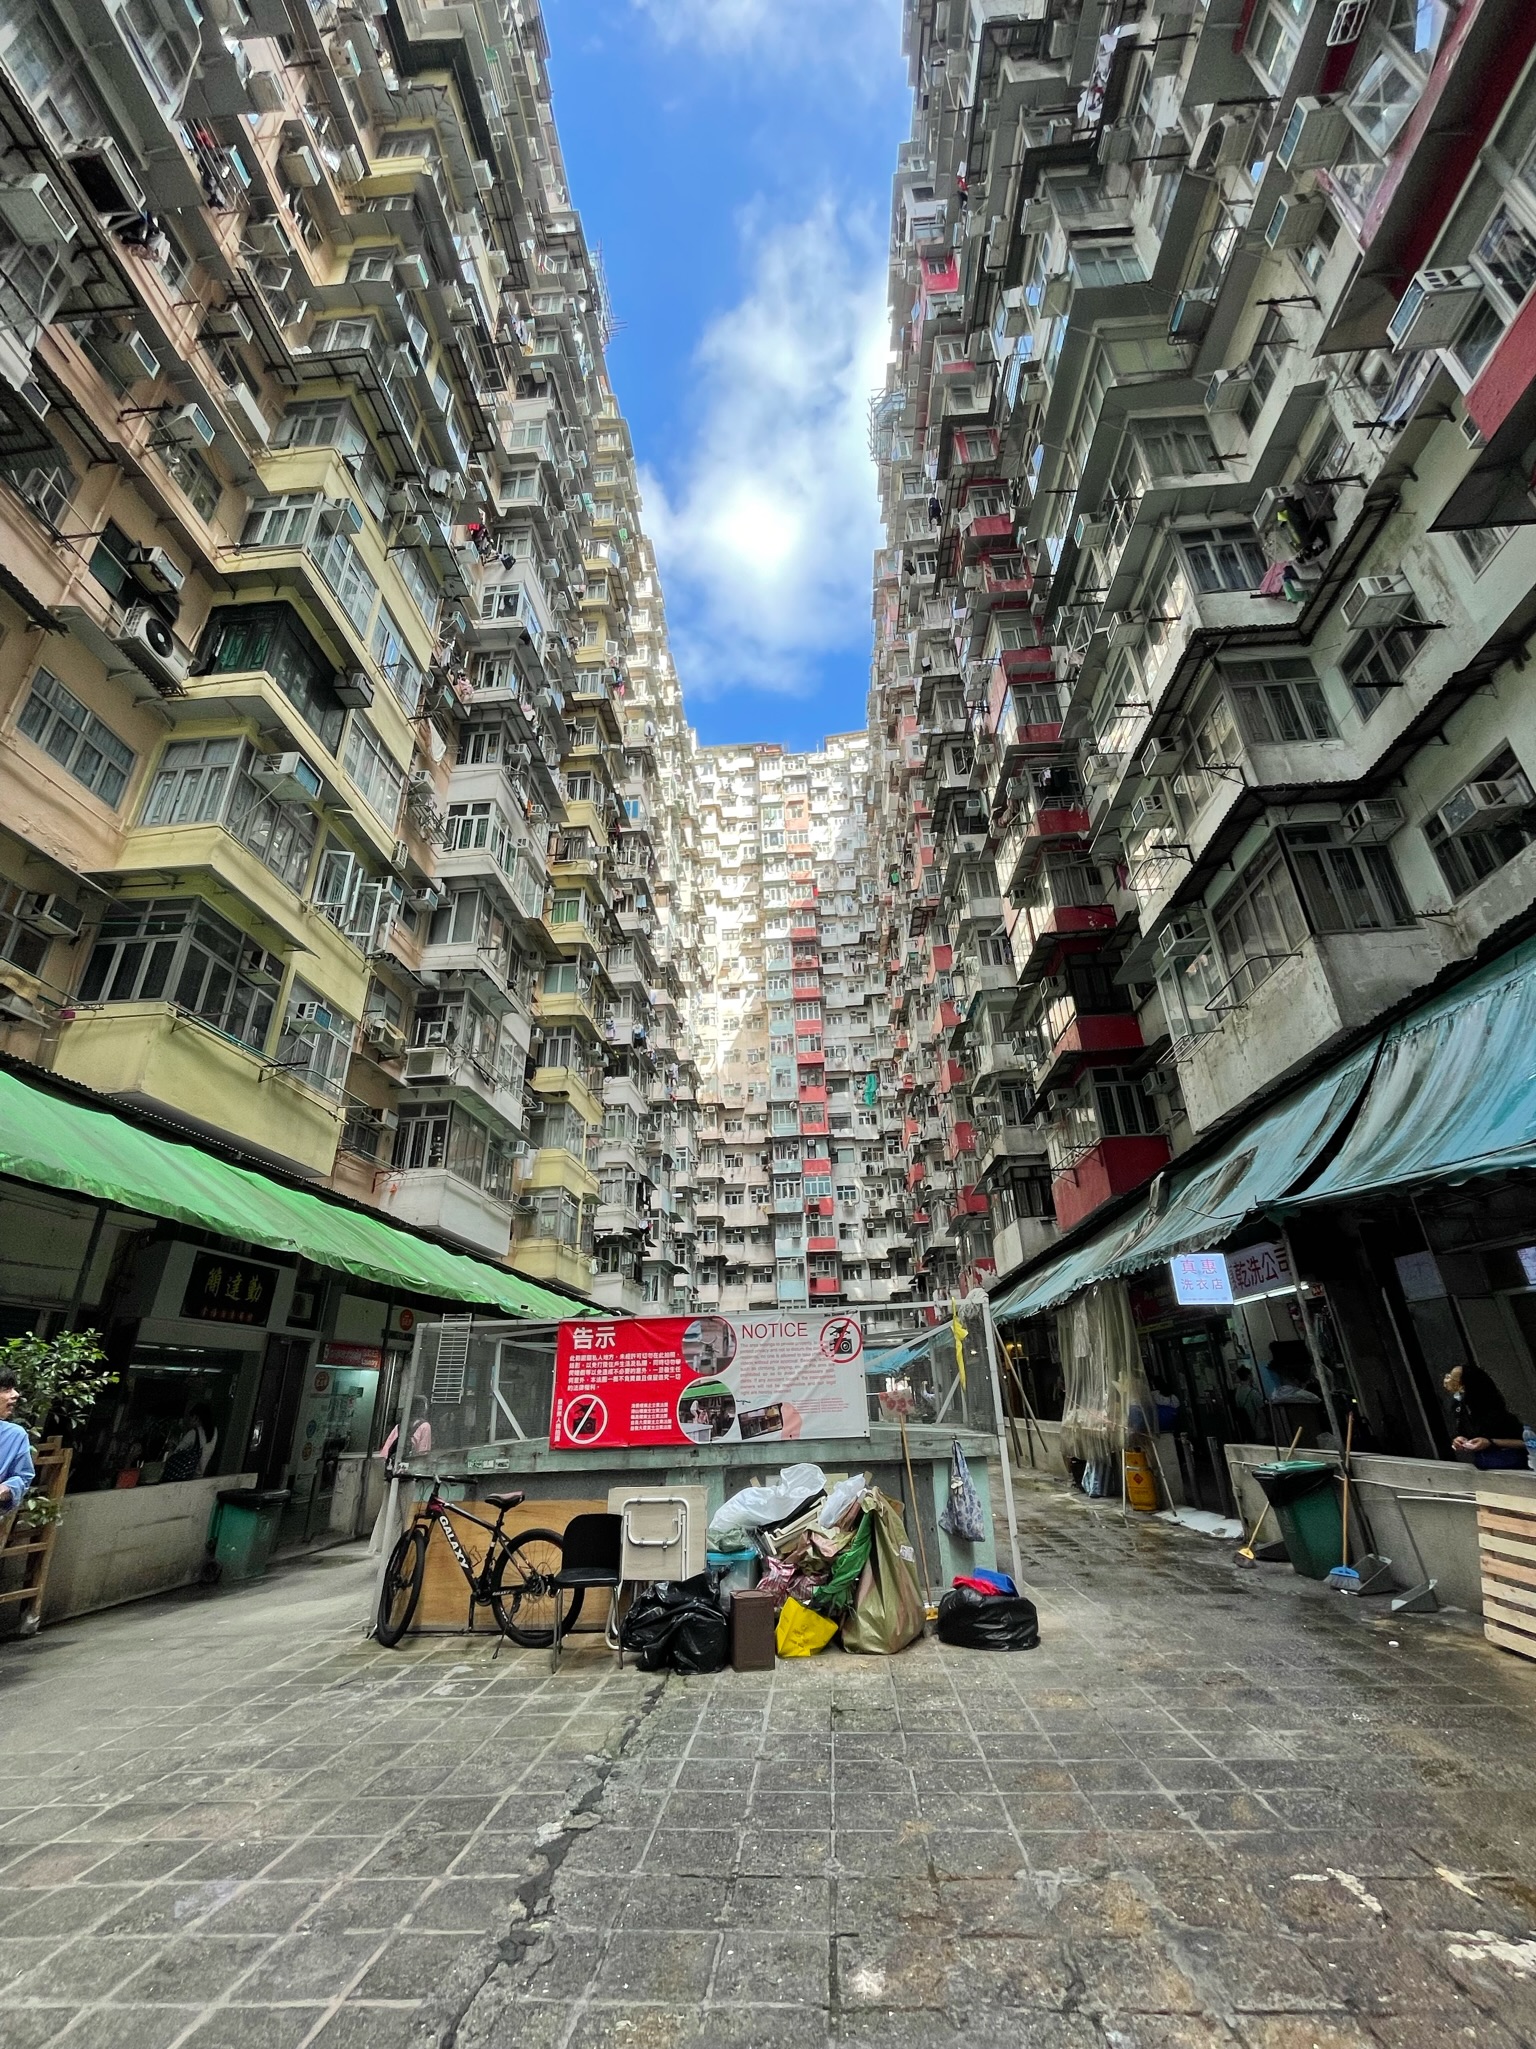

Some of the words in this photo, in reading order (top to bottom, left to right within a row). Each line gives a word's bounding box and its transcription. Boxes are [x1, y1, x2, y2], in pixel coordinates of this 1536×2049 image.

[1180, 1259, 1217, 1275] 真惠
[1180, 1278, 1223, 1290] 洗衣店
[572, 1326, 616, 1350] 告示
[742, 1322, 808, 1339] NOTICE
[440, 1516, 469, 1569] GALAXY
